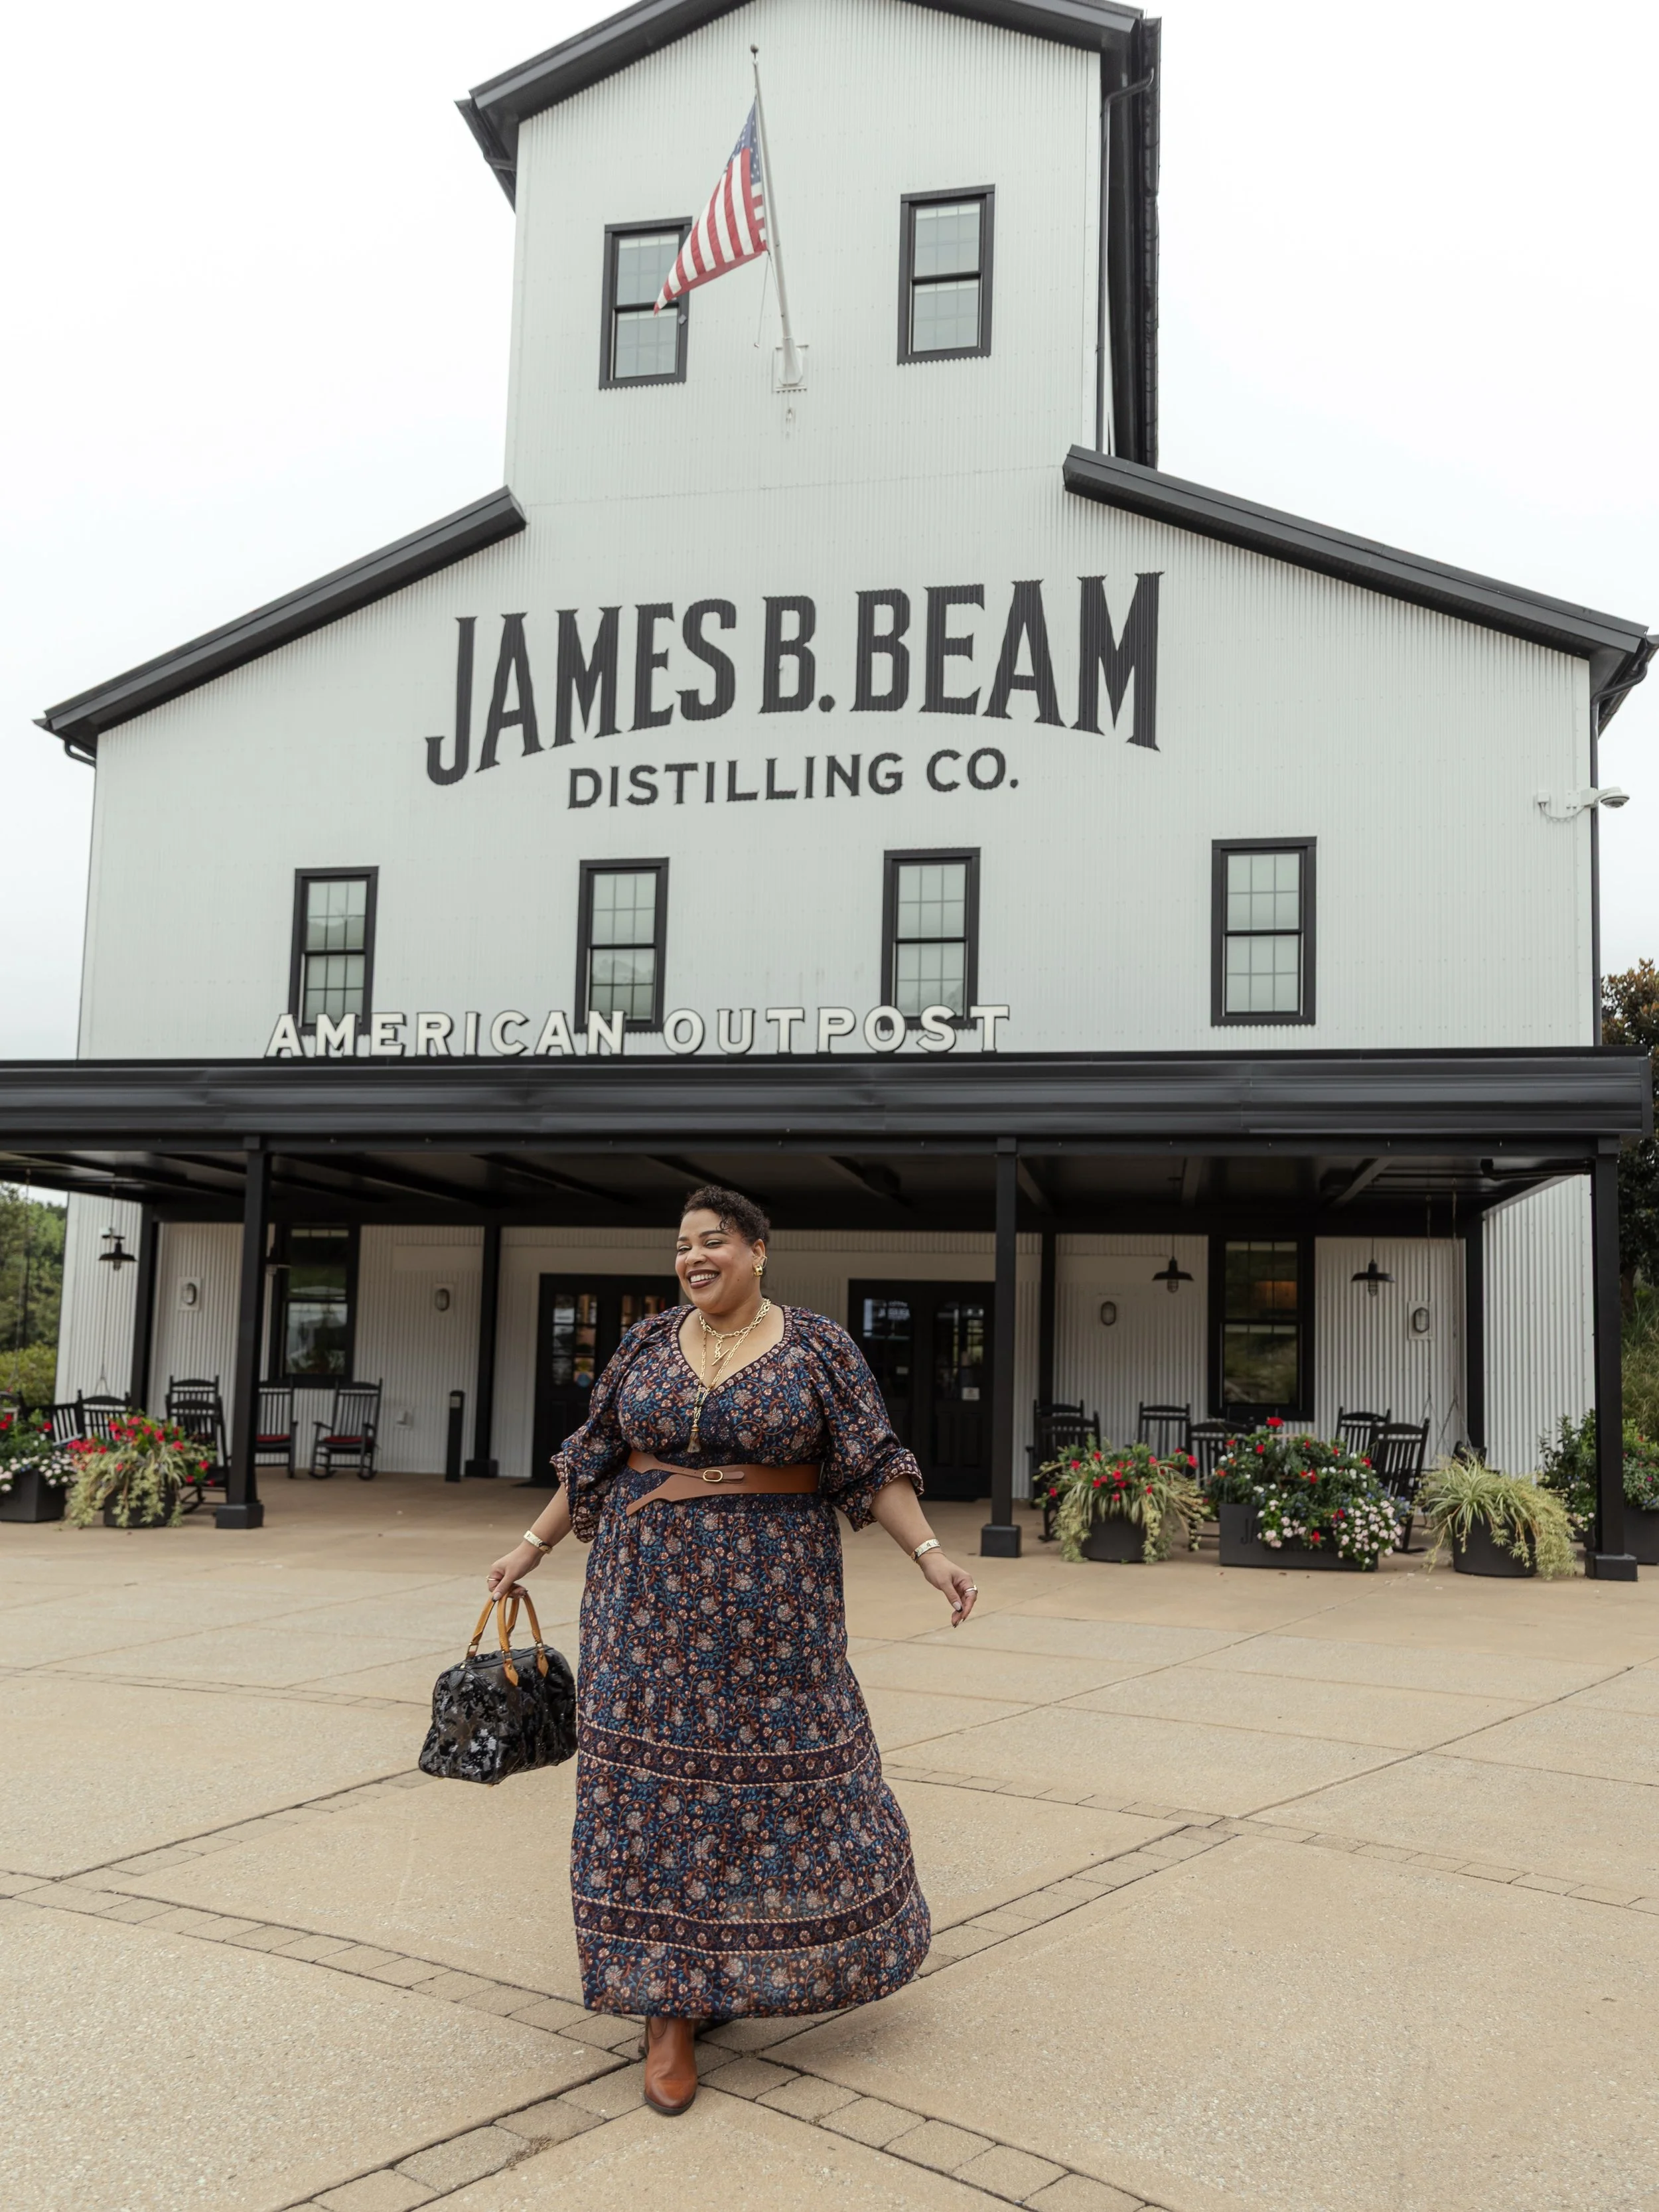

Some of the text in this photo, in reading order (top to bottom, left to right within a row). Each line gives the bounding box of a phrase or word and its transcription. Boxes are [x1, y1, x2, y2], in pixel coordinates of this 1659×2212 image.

[425, 571, 1165, 786] JAMES B. BEAM
[568, 748, 1019, 809] DISTILLING CO.
[265, 1005, 1010, 1057] AMERICAN OUTPOST
